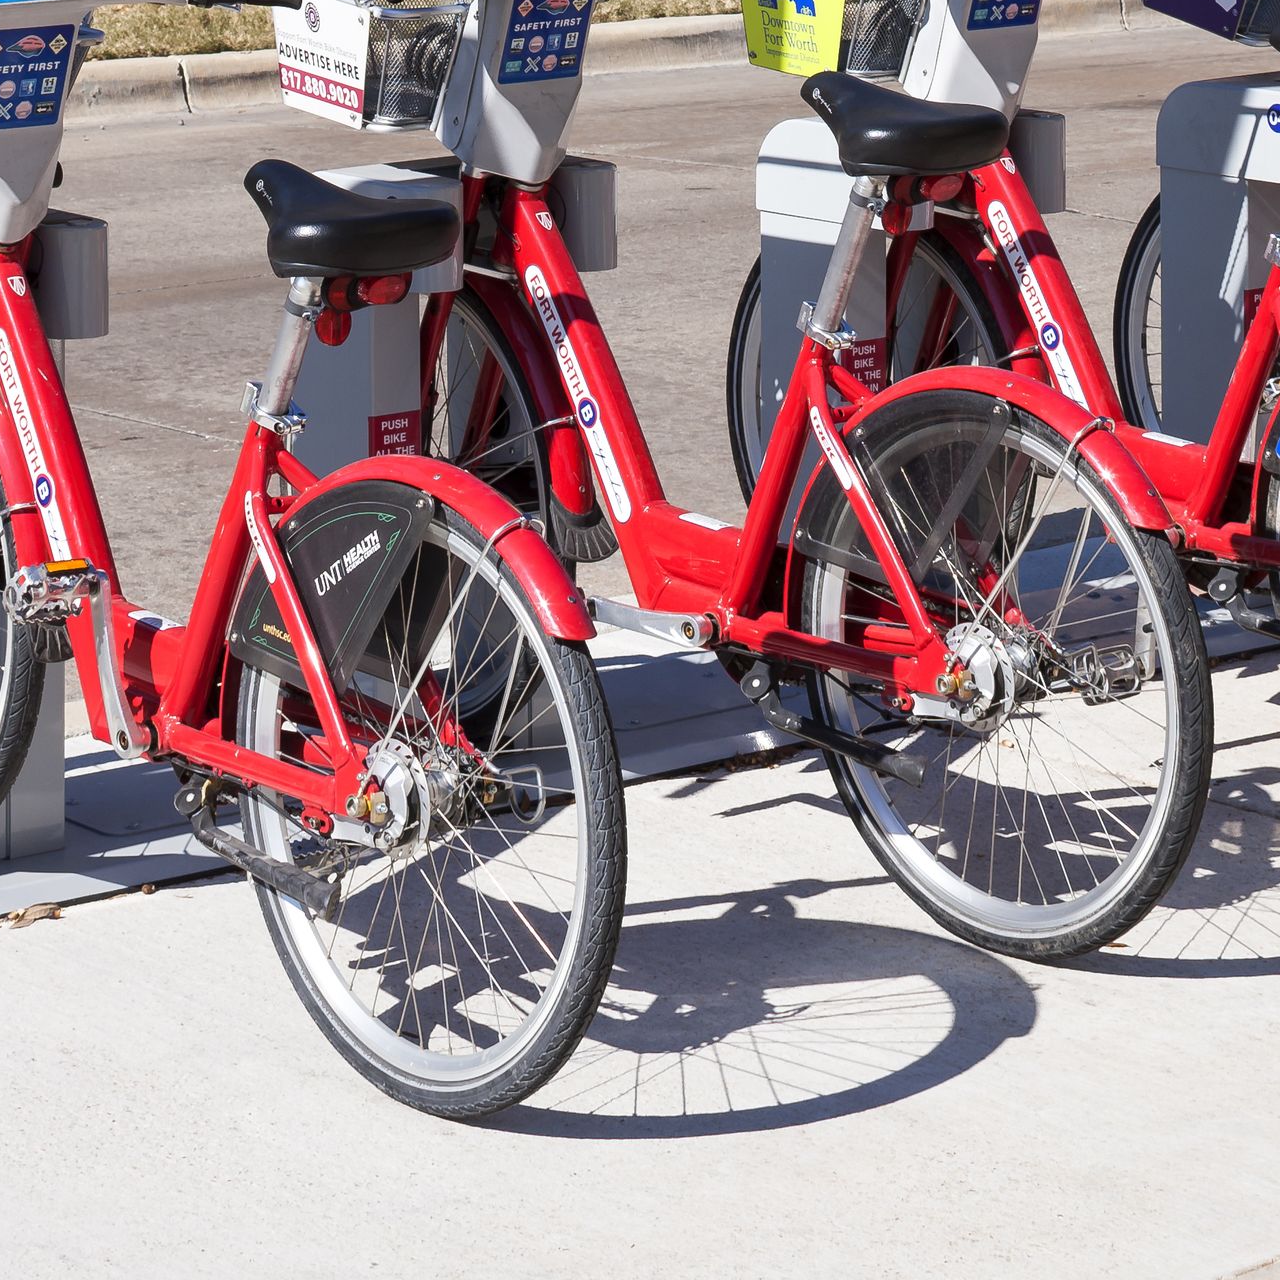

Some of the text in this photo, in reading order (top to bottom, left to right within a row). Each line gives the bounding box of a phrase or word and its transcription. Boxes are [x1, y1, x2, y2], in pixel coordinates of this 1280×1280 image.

[514, 17, 582, 32] SAFETY FIRST
[761, 10, 816, 35] Downtown
[763, 26, 818, 53] Fort Worth
[28, 61, 61, 72] FIRST
[279, 42, 360, 80] ADVERTISE HERE
[280, 67, 360, 109] 817.880.9020
[992, 209, 1047, 322] FORT WORTH
[530, 274, 584, 398] FORT WORTH
[852, 345, 876, 357] PUSH
[854, 357, 874, 369] BIKE
[865, 369, 881, 380] THE
[870, 383, 879, 392] IN
[381, 418, 409, 431] PUSH
[13, 393, 41, 473] WORTH
[383, 432, 407, 445] BIKE
[395, 445, 415, 456] THE
[314, 529, 380, 597] UNT HEALTH
